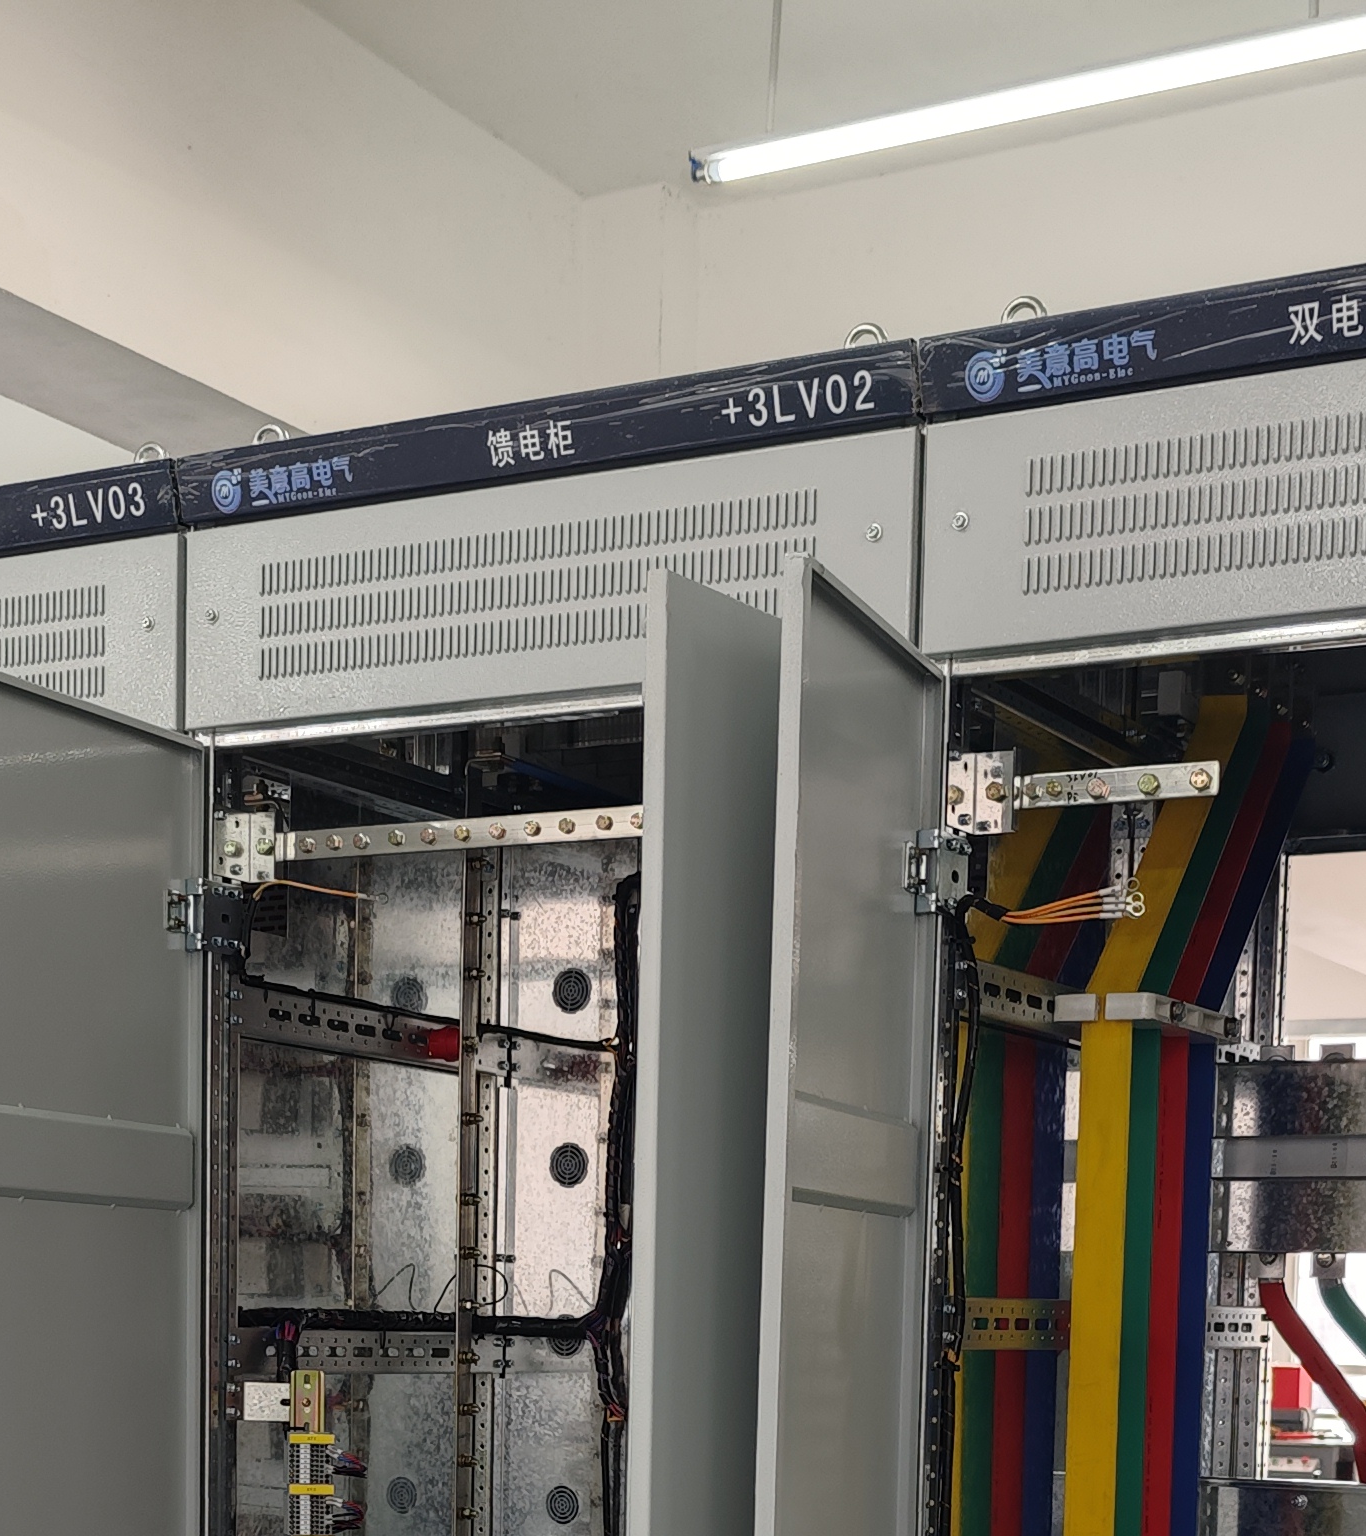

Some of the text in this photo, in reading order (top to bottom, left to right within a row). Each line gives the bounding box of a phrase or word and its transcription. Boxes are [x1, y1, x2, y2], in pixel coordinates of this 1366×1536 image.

[1016, 329, 1158, 389] 美意高电气
[721, 369, 876, 429] +3LV02
[487, 419, 576, 468] 馈电柜
[248, 455, 354, 504] 美意高电气
[29, 482, 147, 532] +3LV03
